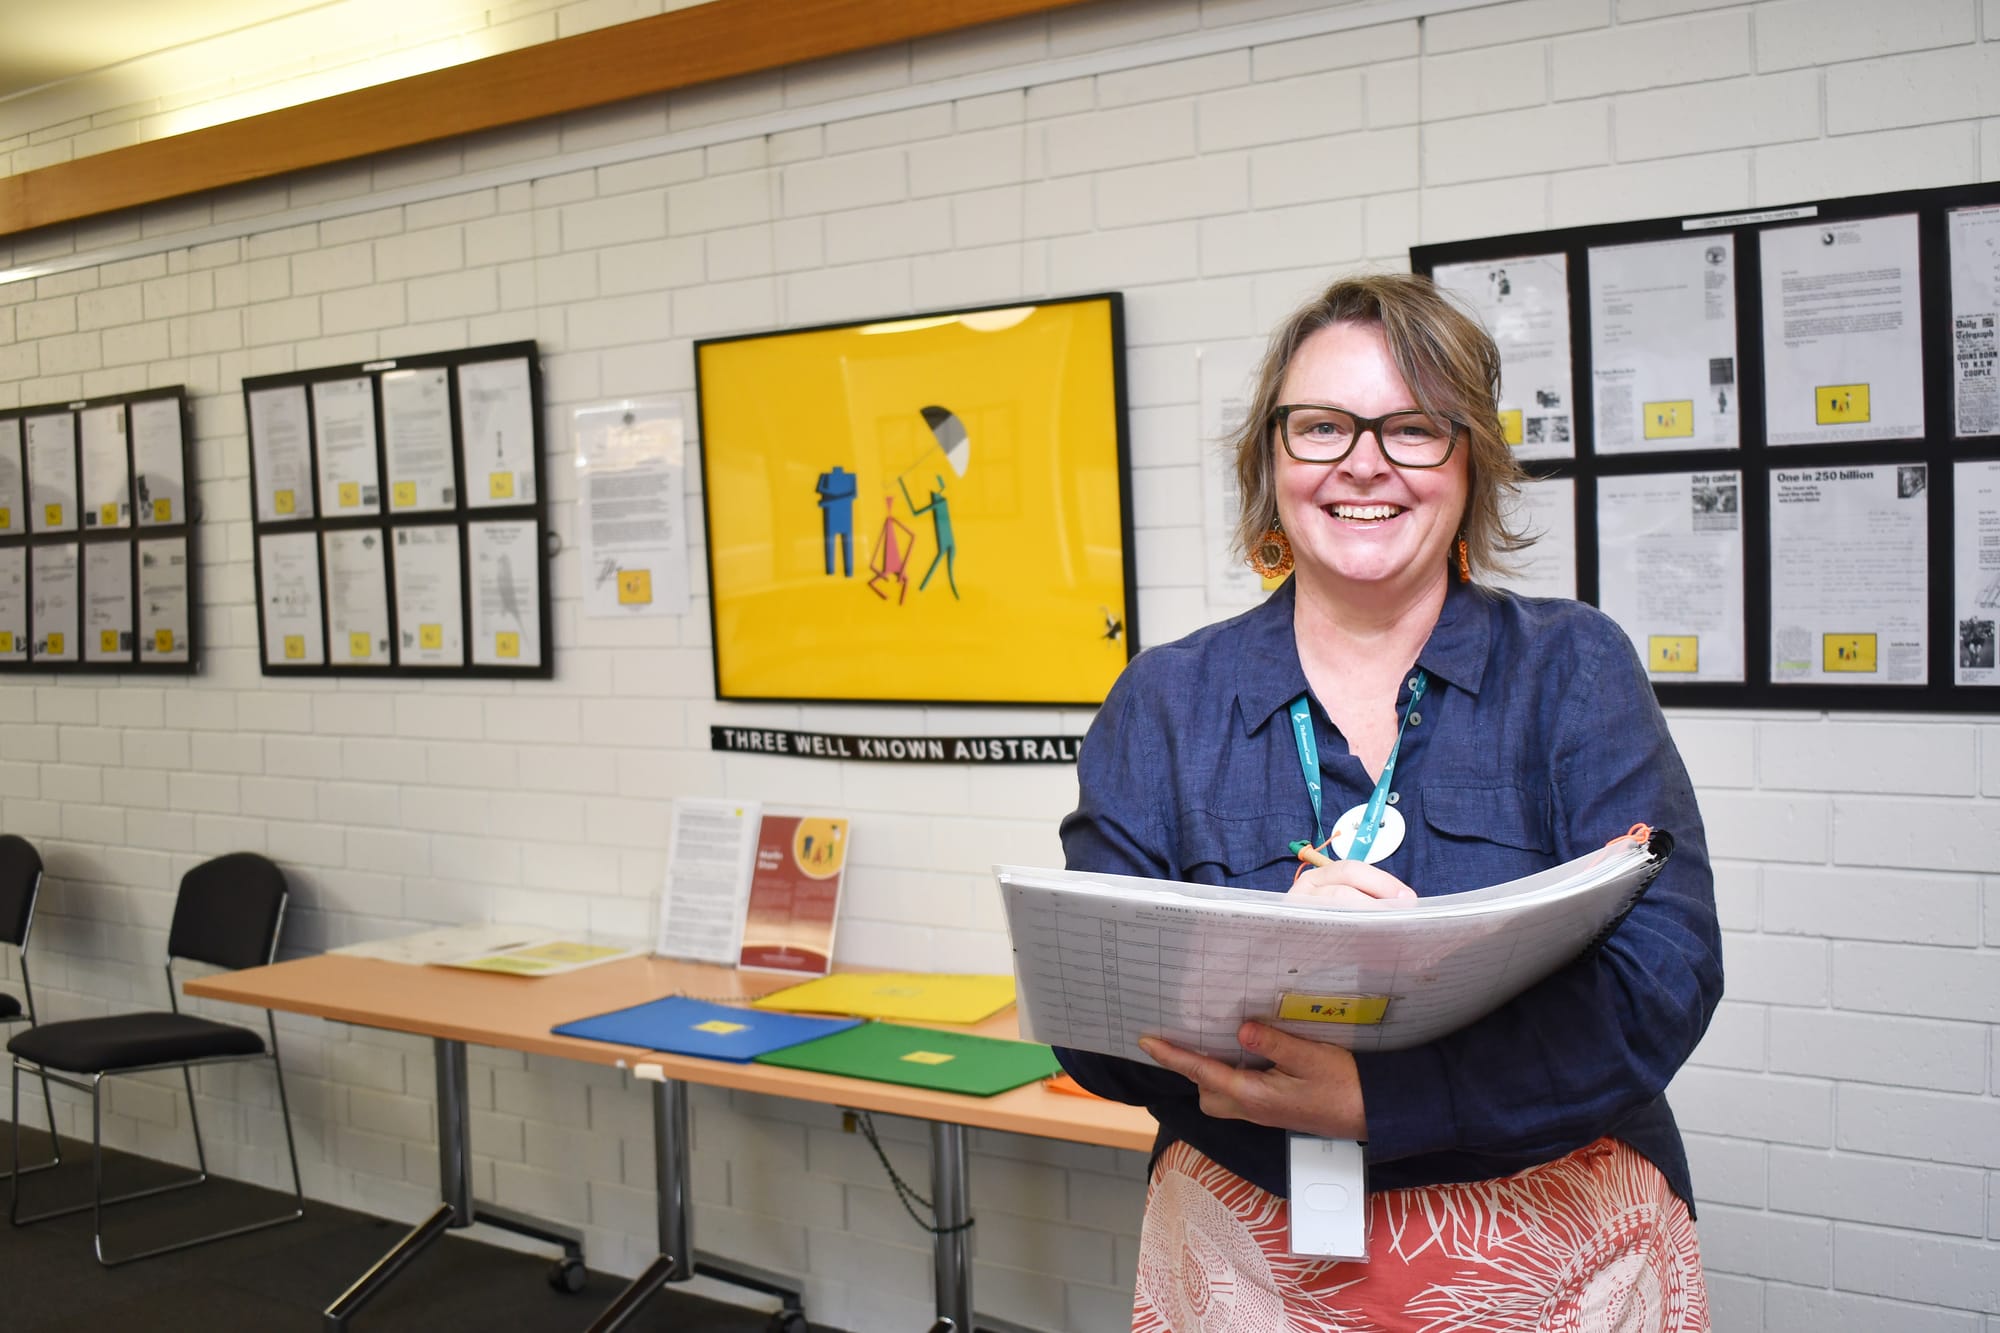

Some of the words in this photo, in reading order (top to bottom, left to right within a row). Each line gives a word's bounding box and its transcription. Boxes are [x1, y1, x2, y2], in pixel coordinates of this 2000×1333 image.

[1956, 319, 1977, 329] Daily
[1956, 329, 1994, 340] Telegraph
[1979, 351, 1998, 359] BORN
[1960, 361, 1969, 369] TO
[1963, 369, 1991, 377] COUPLE
[1777, 472, 1800, 482] One
[1802, 472, 1812, 482] in
[1815, 471, 1837, 482] 250
[1839, 469, 1875, 481] billion
[724, 730, 788, 751] THREE
[794, 735, 851, 757] WELL
[857, 738, 945, 760] KNOWN
